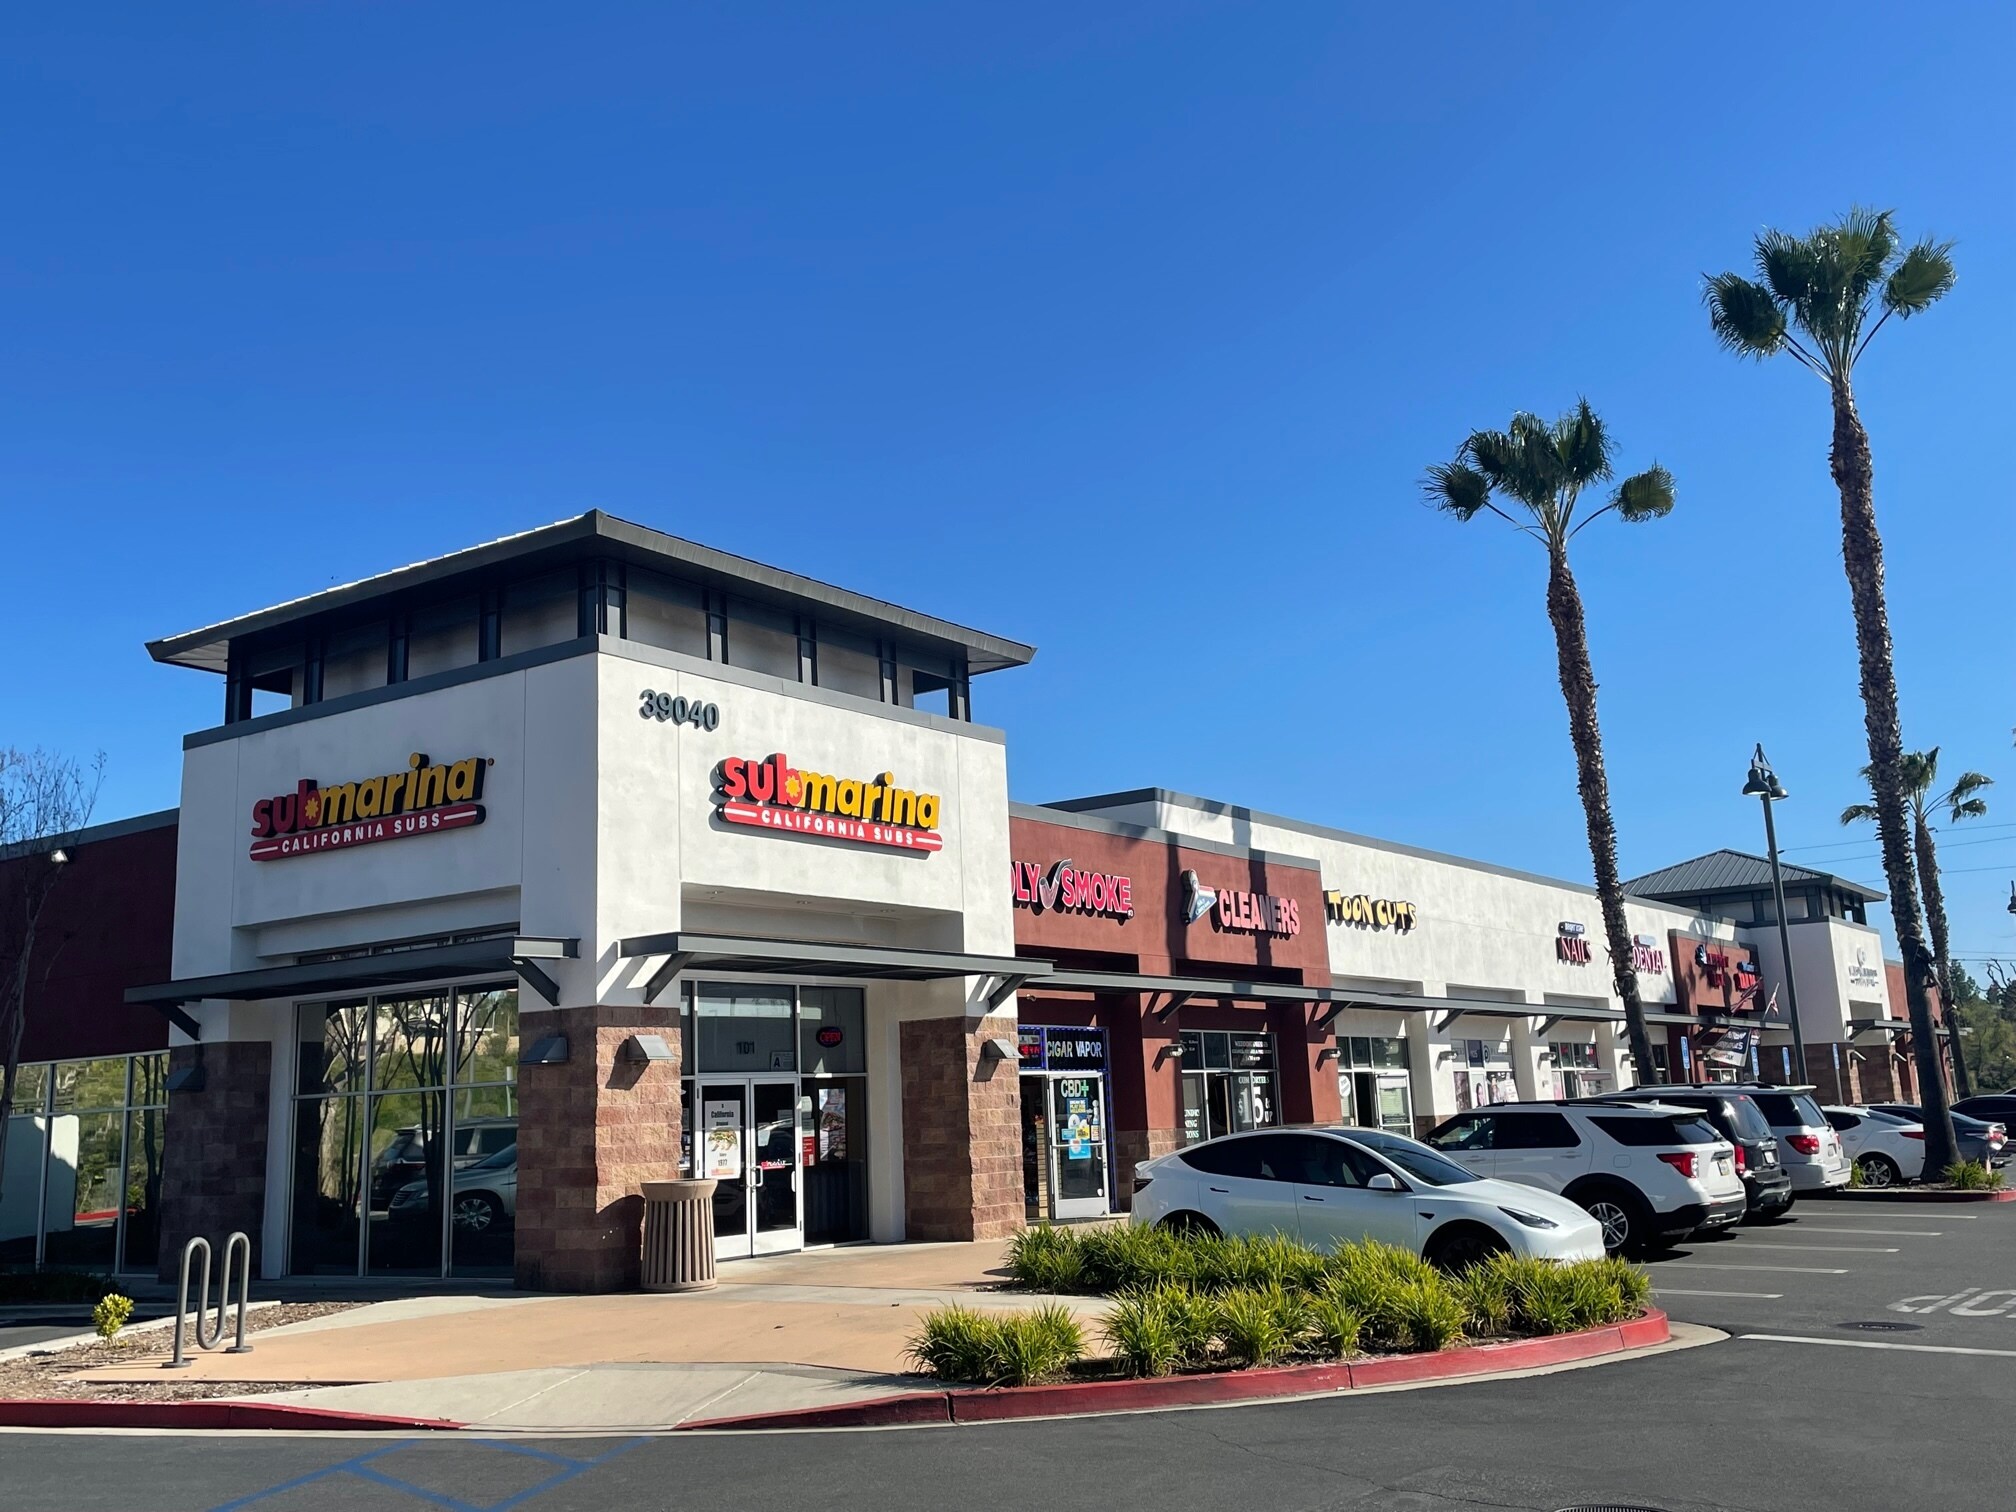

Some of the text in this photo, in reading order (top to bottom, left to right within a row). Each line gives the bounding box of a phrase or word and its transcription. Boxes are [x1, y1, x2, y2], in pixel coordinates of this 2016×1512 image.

[639, 689, 720, 732] 39040
[251, 752, 483, 838] submarina
[723, 753, 941, 830] submarina
[282, 813, 440, 853] CALIFORNIA SUBS
[761, 810, 913, 844] CALIFORNIA SUBS
[1062, 868, 1131, 913] SMOKE
[1325, 889, 1417, 930] TOON CUTS
[1219, 888, 1301, 935] CLEANERS
[1560, 936, 1592, 963] NAILS
[736, 1041, 755, 1055] 101
[774, 1056, 781, 1068] A
[1047, 1040, 1073, 1057] CIGAR
[1075, 1040, 1102, 1058] VAPOR
